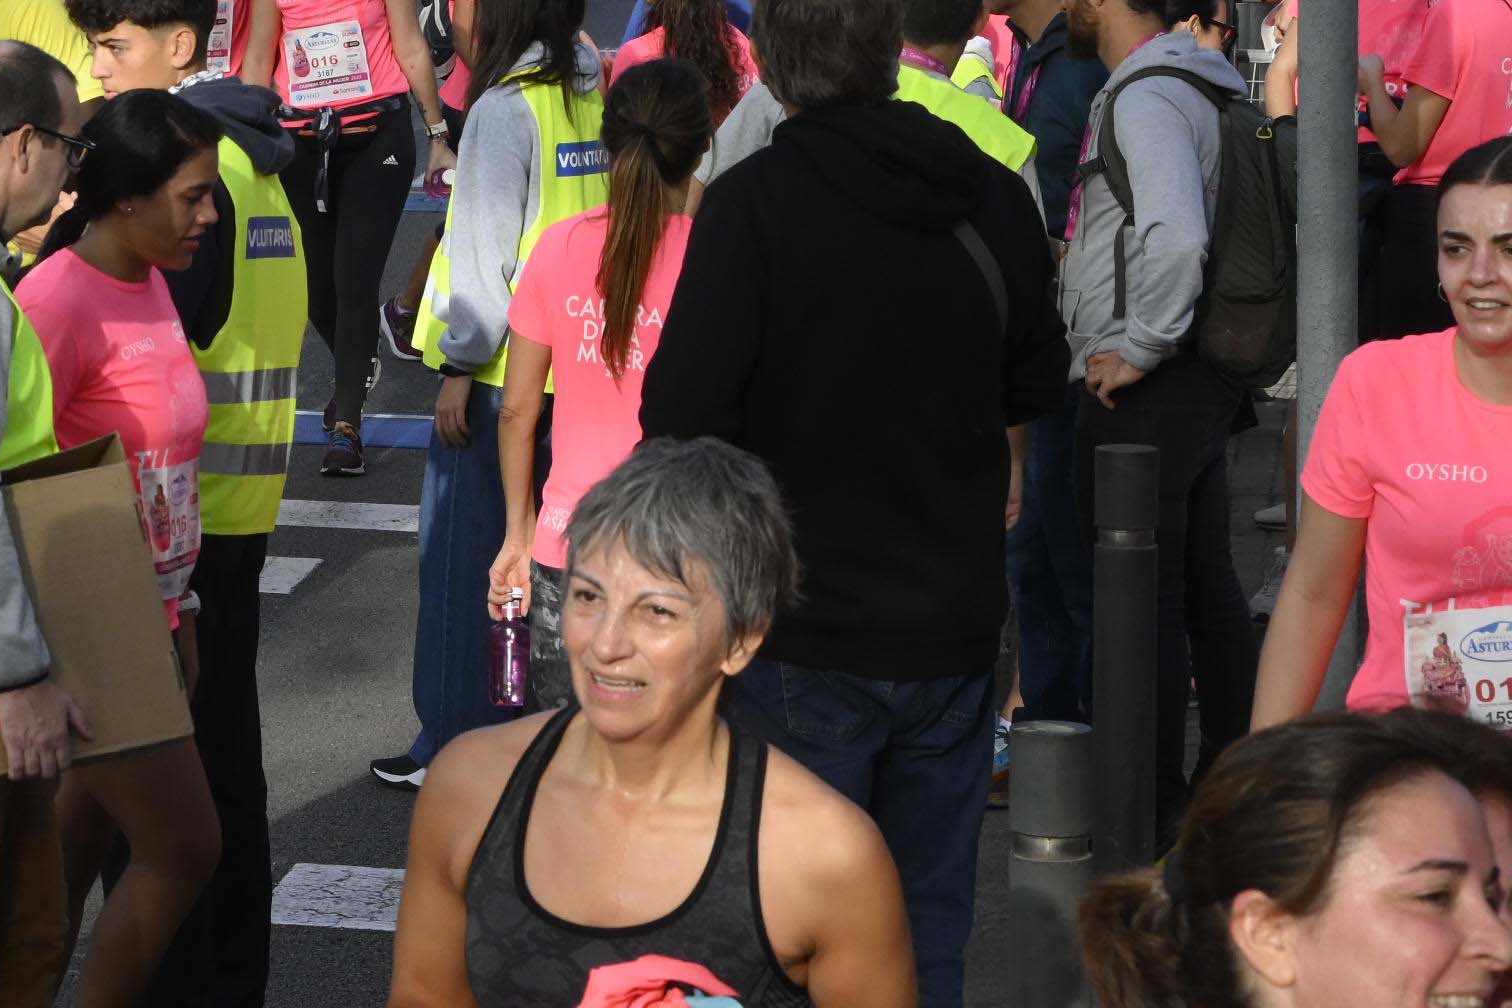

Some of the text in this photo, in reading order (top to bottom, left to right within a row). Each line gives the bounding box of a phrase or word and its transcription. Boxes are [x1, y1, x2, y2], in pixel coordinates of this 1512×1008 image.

[312, 55, 338, 68] 016
[317, 69, 334, 78] 3187
[1406, 463, 1488, 483] OYSHO
[170, 515, 187, 537] 016
[1476, 679, 1512, 703] 01
